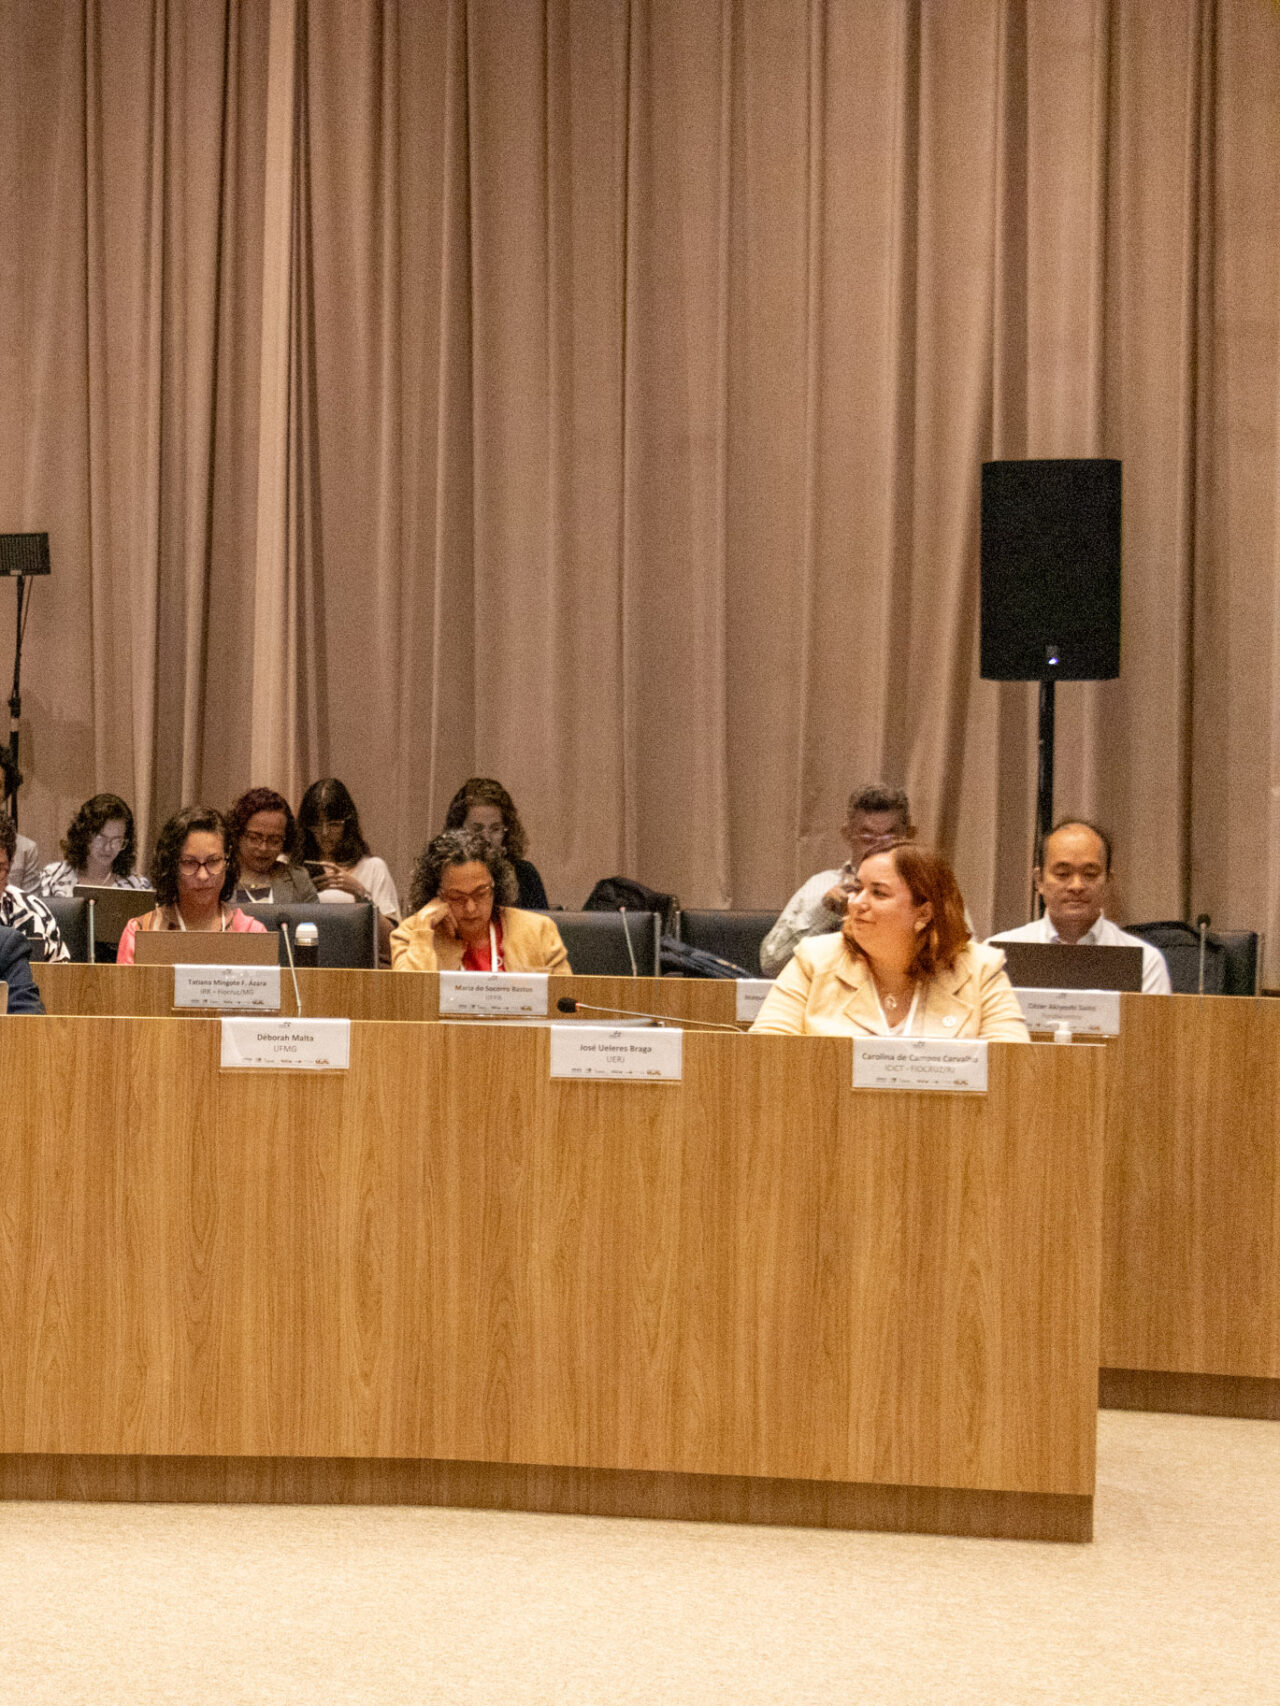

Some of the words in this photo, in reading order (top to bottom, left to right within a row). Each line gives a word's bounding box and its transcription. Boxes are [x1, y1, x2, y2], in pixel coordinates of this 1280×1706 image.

[256, 1033, 290, 1041] Déborah
[630, 1045, 652, 1054] Braga
[862, 1052, 894, 1060] Carolina
